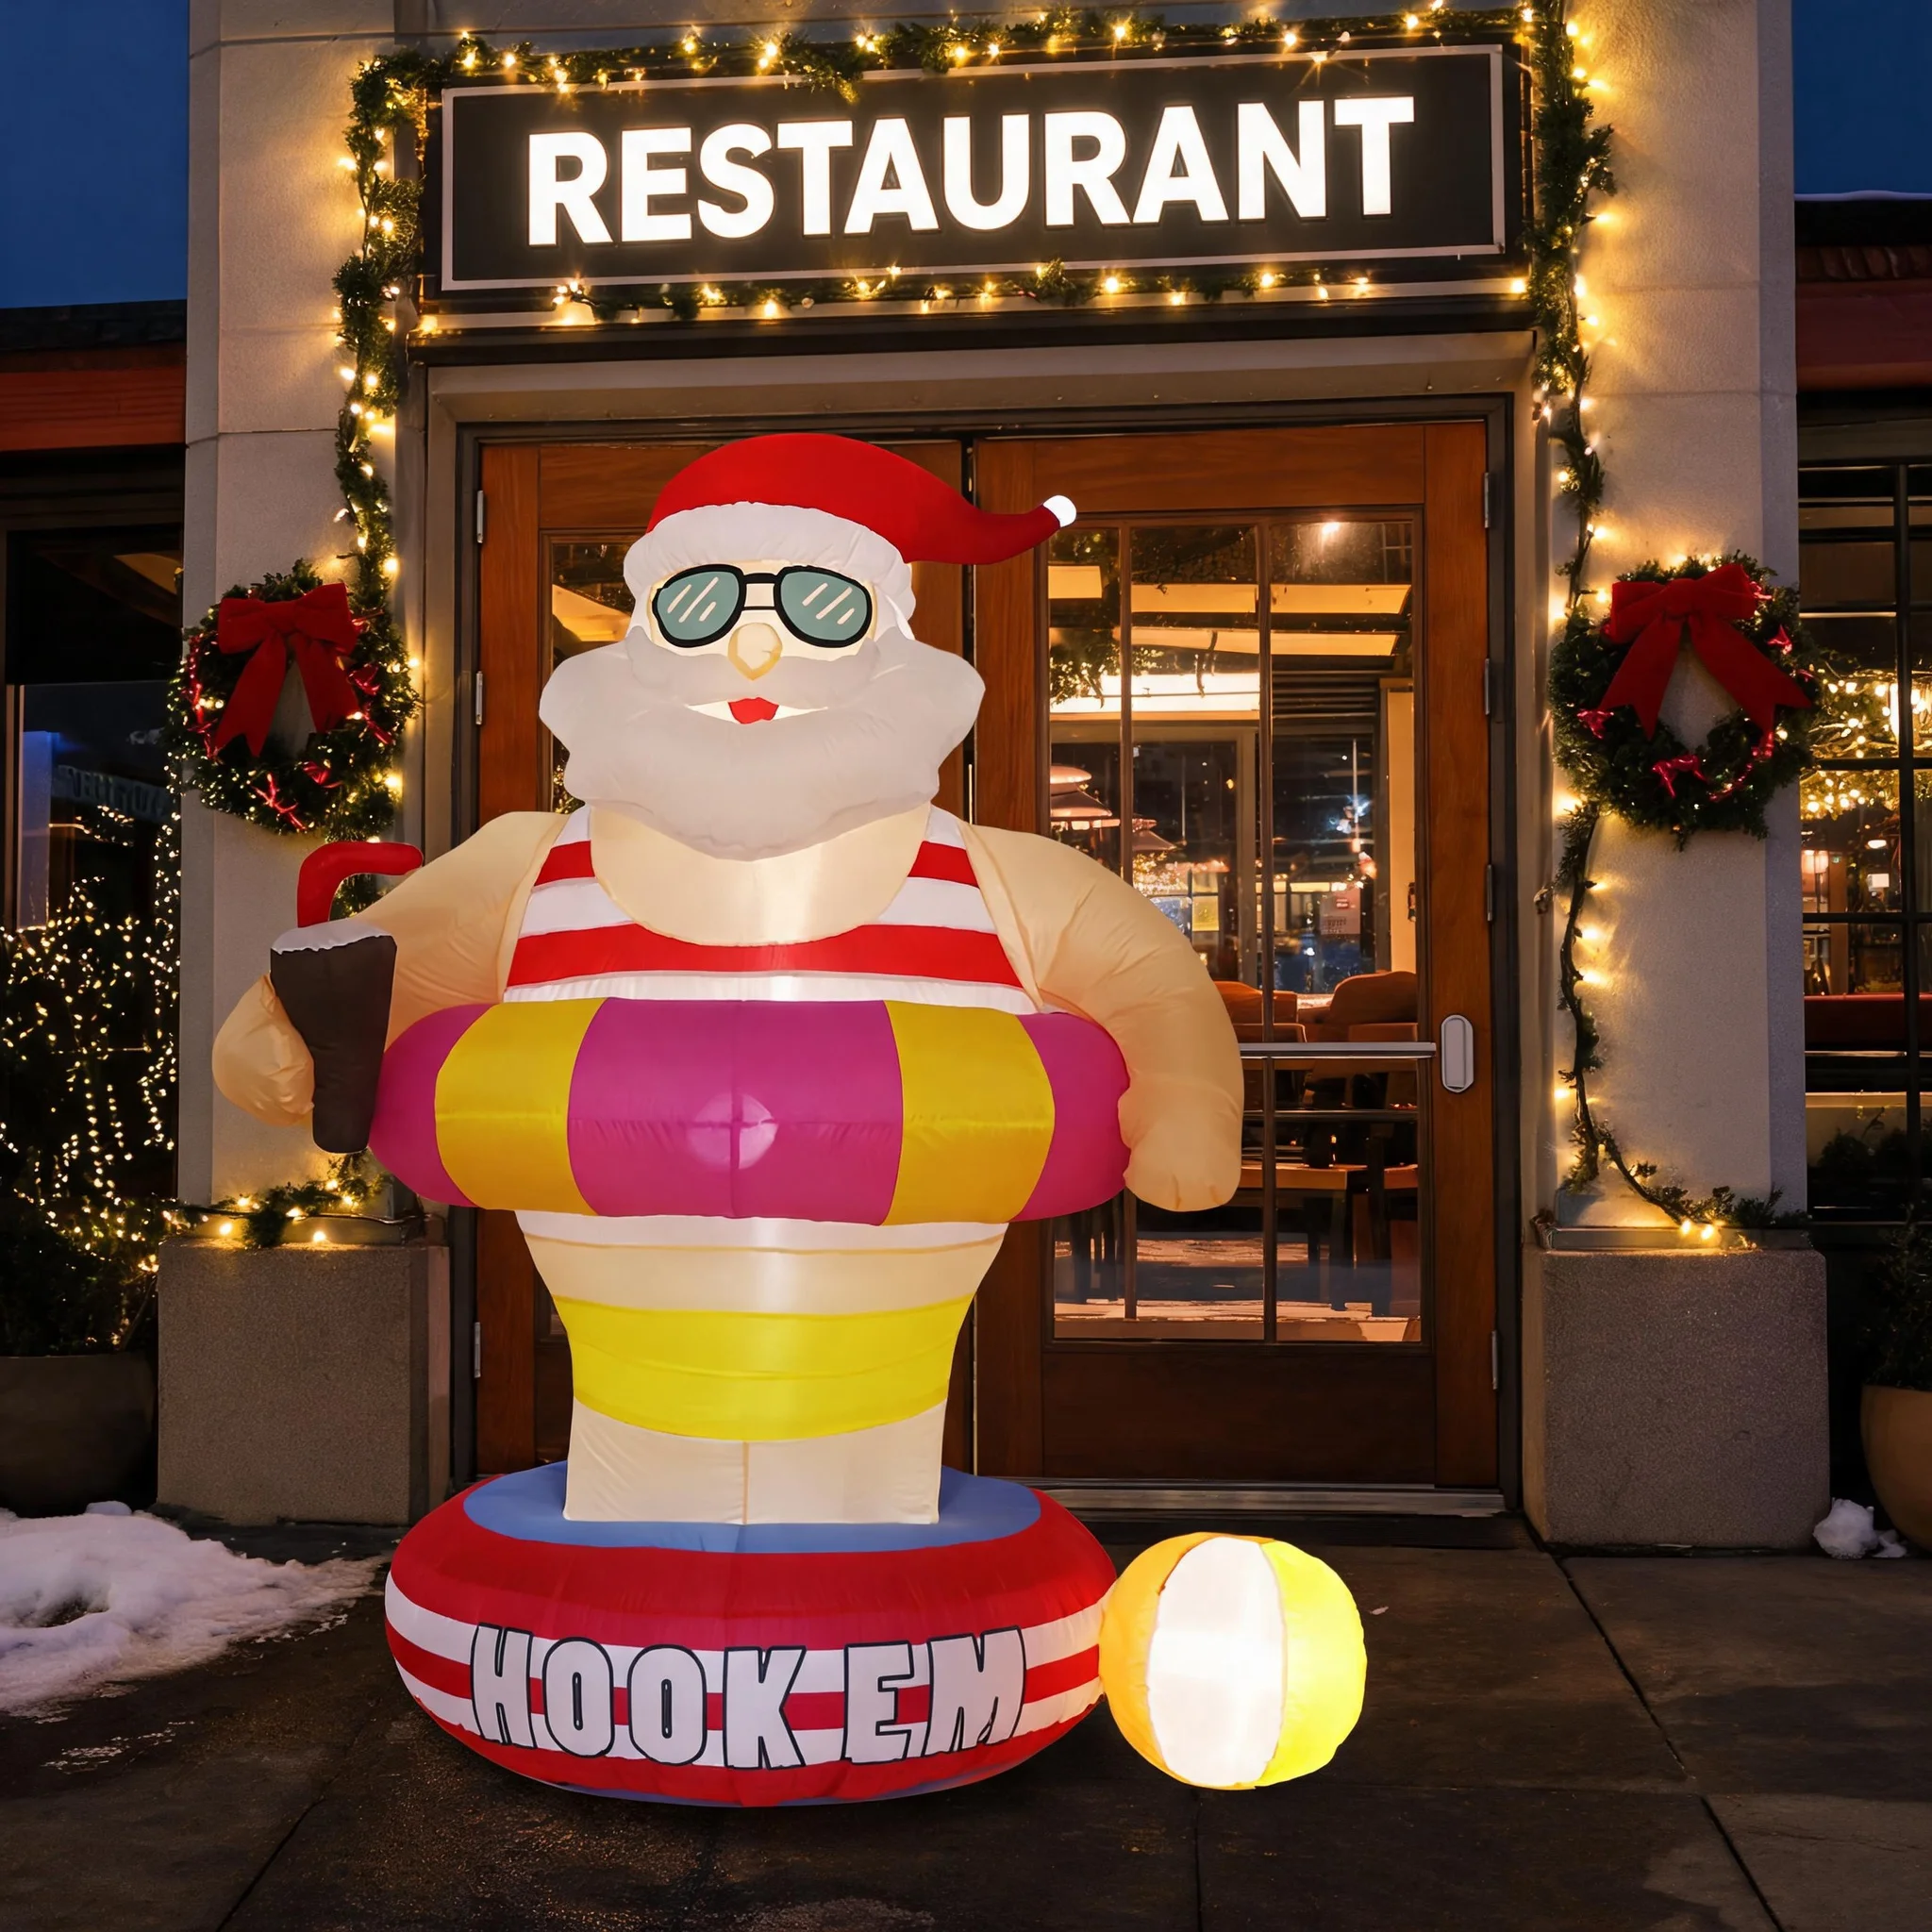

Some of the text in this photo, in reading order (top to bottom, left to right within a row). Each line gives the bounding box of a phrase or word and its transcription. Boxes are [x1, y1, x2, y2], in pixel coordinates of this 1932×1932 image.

[527, 96, 1415, 246] RESTAURANT
[471, 1623, 1026, 1770] HOOK EM
